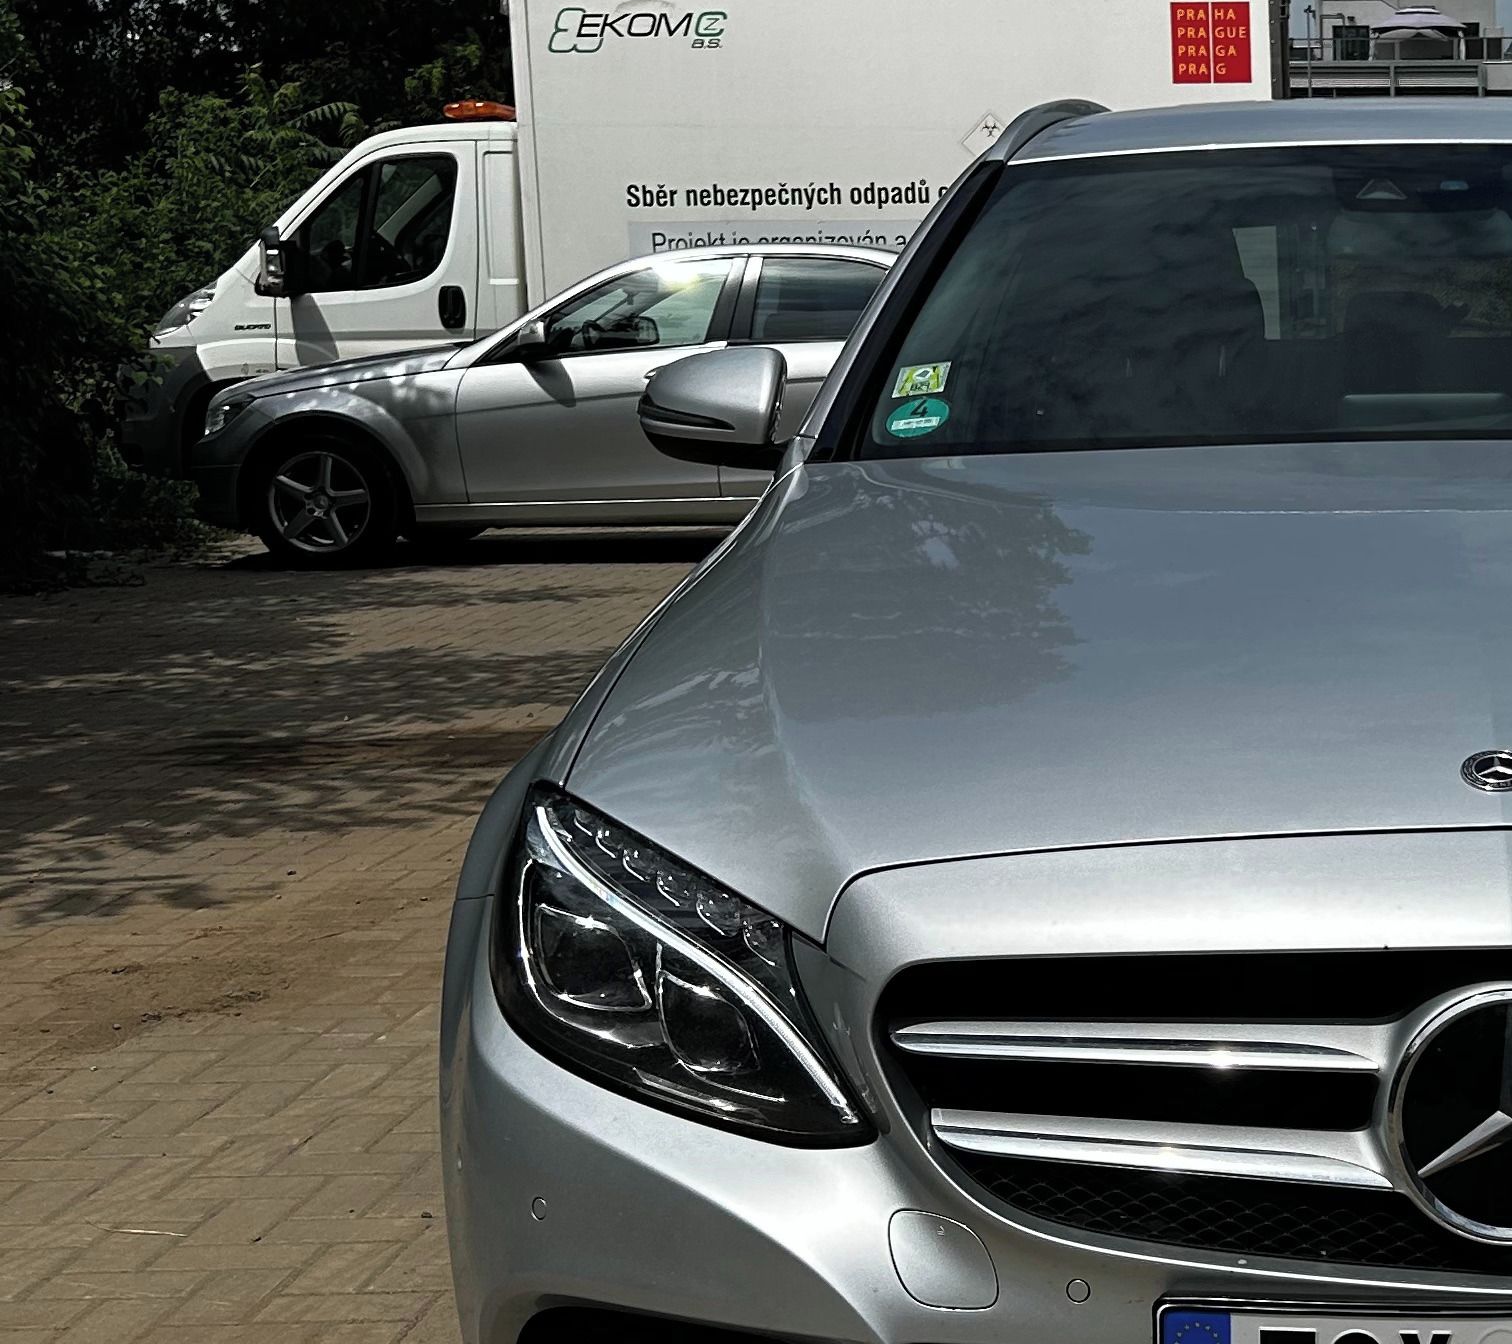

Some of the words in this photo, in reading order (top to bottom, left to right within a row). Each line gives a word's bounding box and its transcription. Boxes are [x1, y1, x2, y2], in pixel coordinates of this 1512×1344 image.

[626, 183, 677, 207] Sběr
[686, 181, 842, 211] nebezpečných
[850, 179, 930, 209] odpadů
